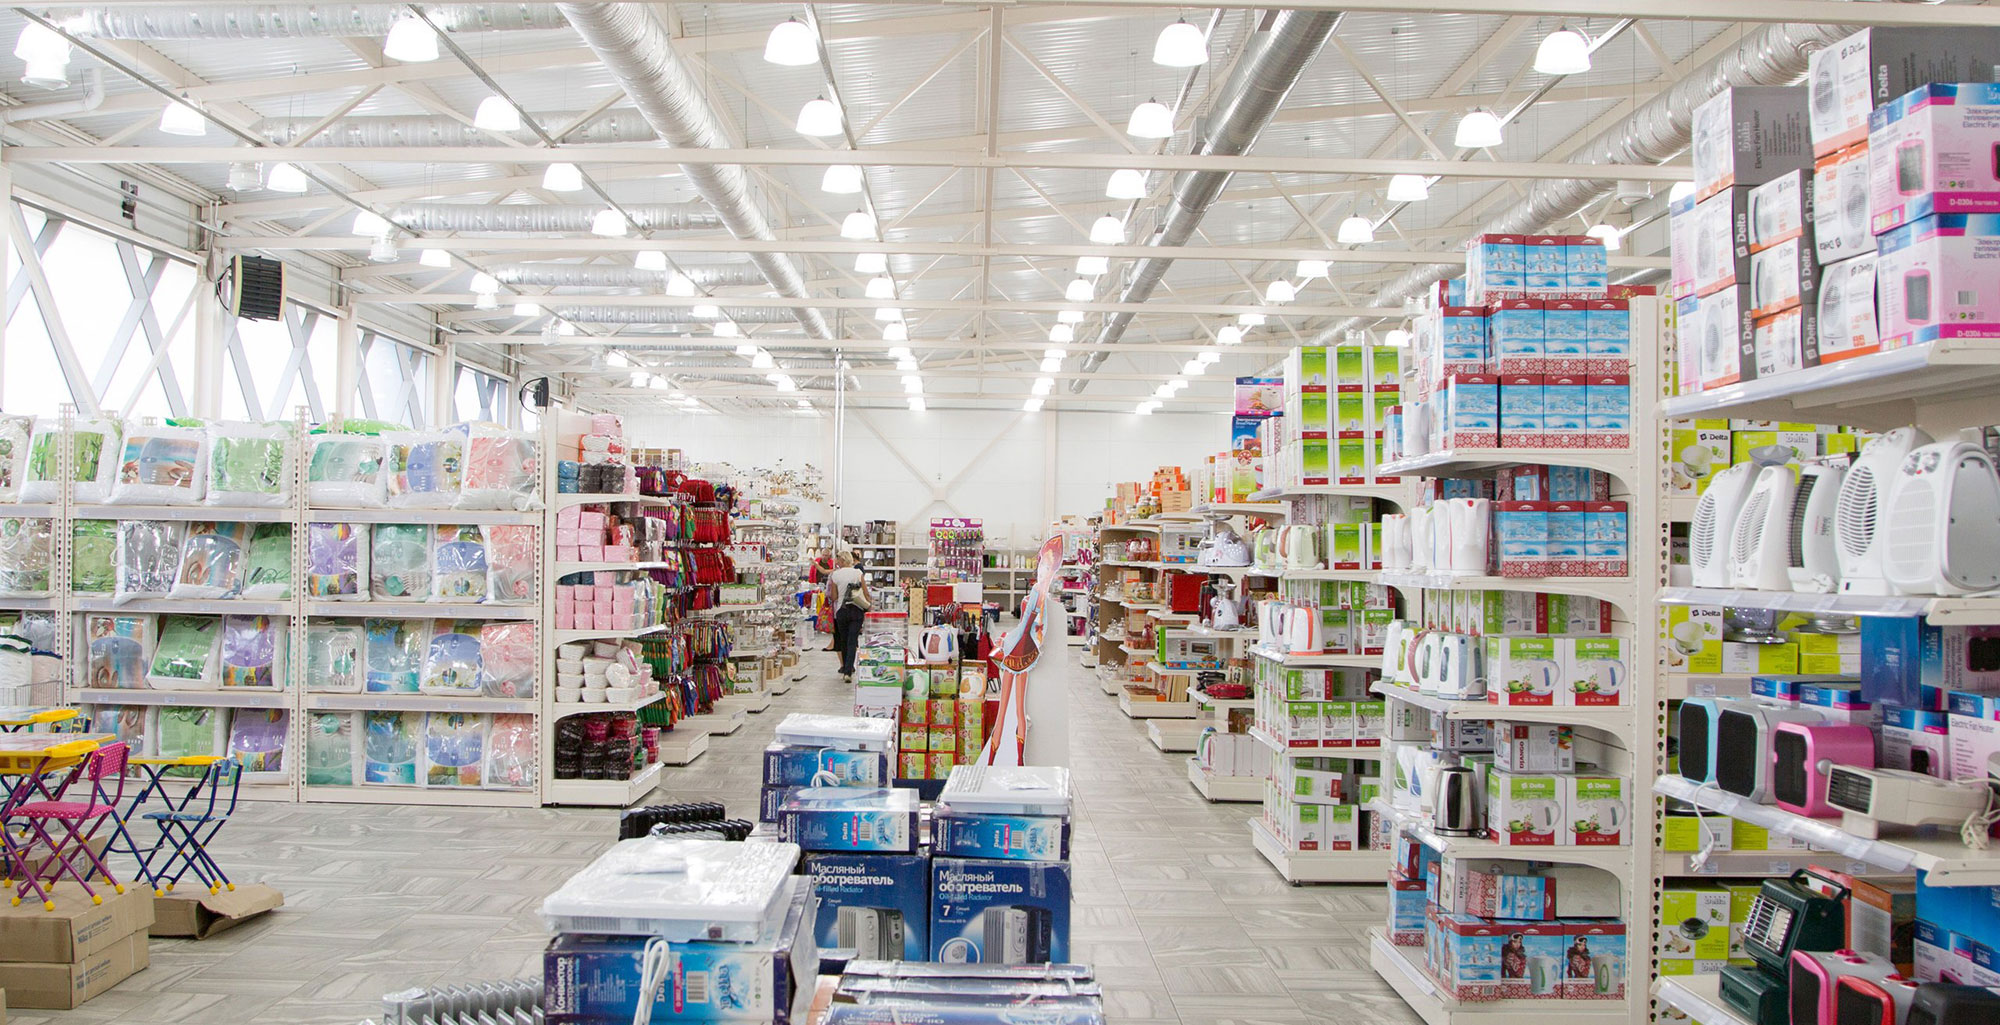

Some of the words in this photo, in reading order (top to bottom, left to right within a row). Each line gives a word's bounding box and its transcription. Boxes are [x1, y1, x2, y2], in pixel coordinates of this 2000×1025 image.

[1878, 64, 1889, 98] Delta
[1753, 109, 1761, 131] Heater
[1754, 145, 1762, 169] Electric
[1805, 180, 1814, 210] Delta
[1737, 212, 1747, 243] Delta
[1802, 248, 1812, 277] Delta
[1743, 310, 1753, 340] Delta
[1806, 316, 1816, 346] Delta
[1702, 609, 1721, 617] Delta
[811, 862, 866, 875] Масляный
[939, 870, 994, 882] Масляный
[812, 873, 894, 886] обогреватель
[939, 881, 1023, 894] обогреватель
[840, 885, 864, 893] Radiator
[968, 893, 993, 901] Radiator
[815, 897, 822, 908] 7
[942, 904, 951, 916] 7
[555, 957, 567, 1014] Конвектор
